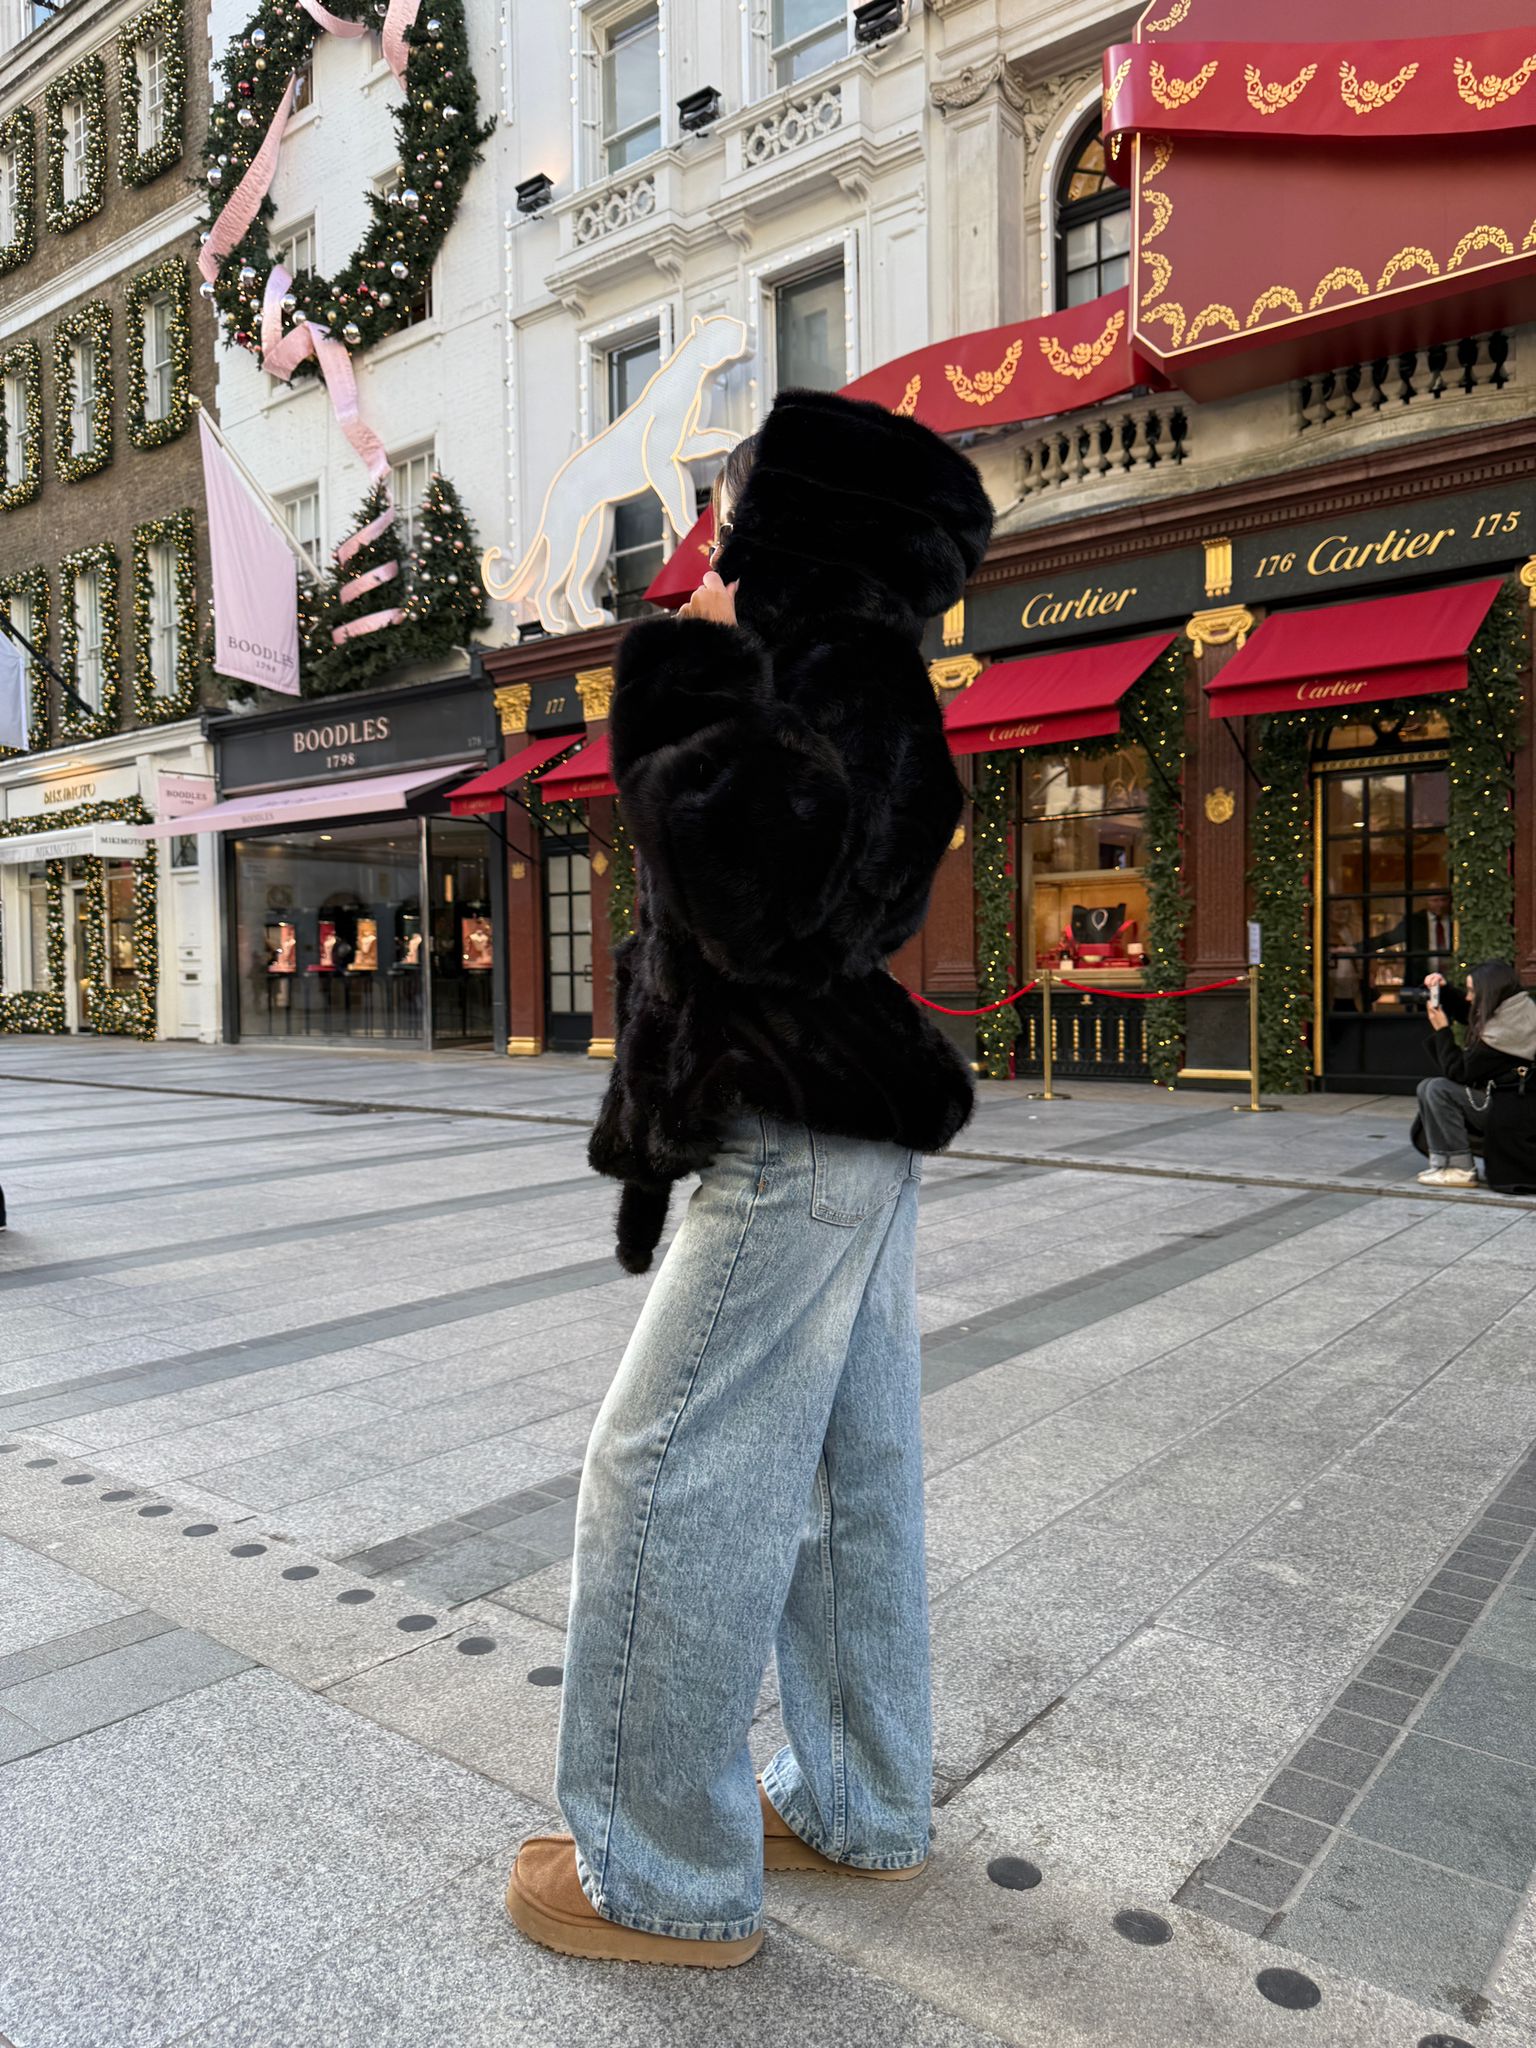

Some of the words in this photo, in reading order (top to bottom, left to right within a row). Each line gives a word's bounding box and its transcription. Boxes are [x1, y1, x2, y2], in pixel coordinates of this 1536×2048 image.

[1254, 552, 1296, 579] 176
[1306, 528, 1456, 576] Cartier
[1471, 511, 1521, 539] 175
[1021, 587, 1138, 629] Cartier
[1296, 680, 1368, 701] Cartier
[293, 716, 391, 753] BOODLES
[988, 722, 1044, 742] Cartier
[326, 752, 356, 769] 1798
[166, 789, 208, 800] BOODLES
[100, 836, 146, 846] MIKIMOTO
